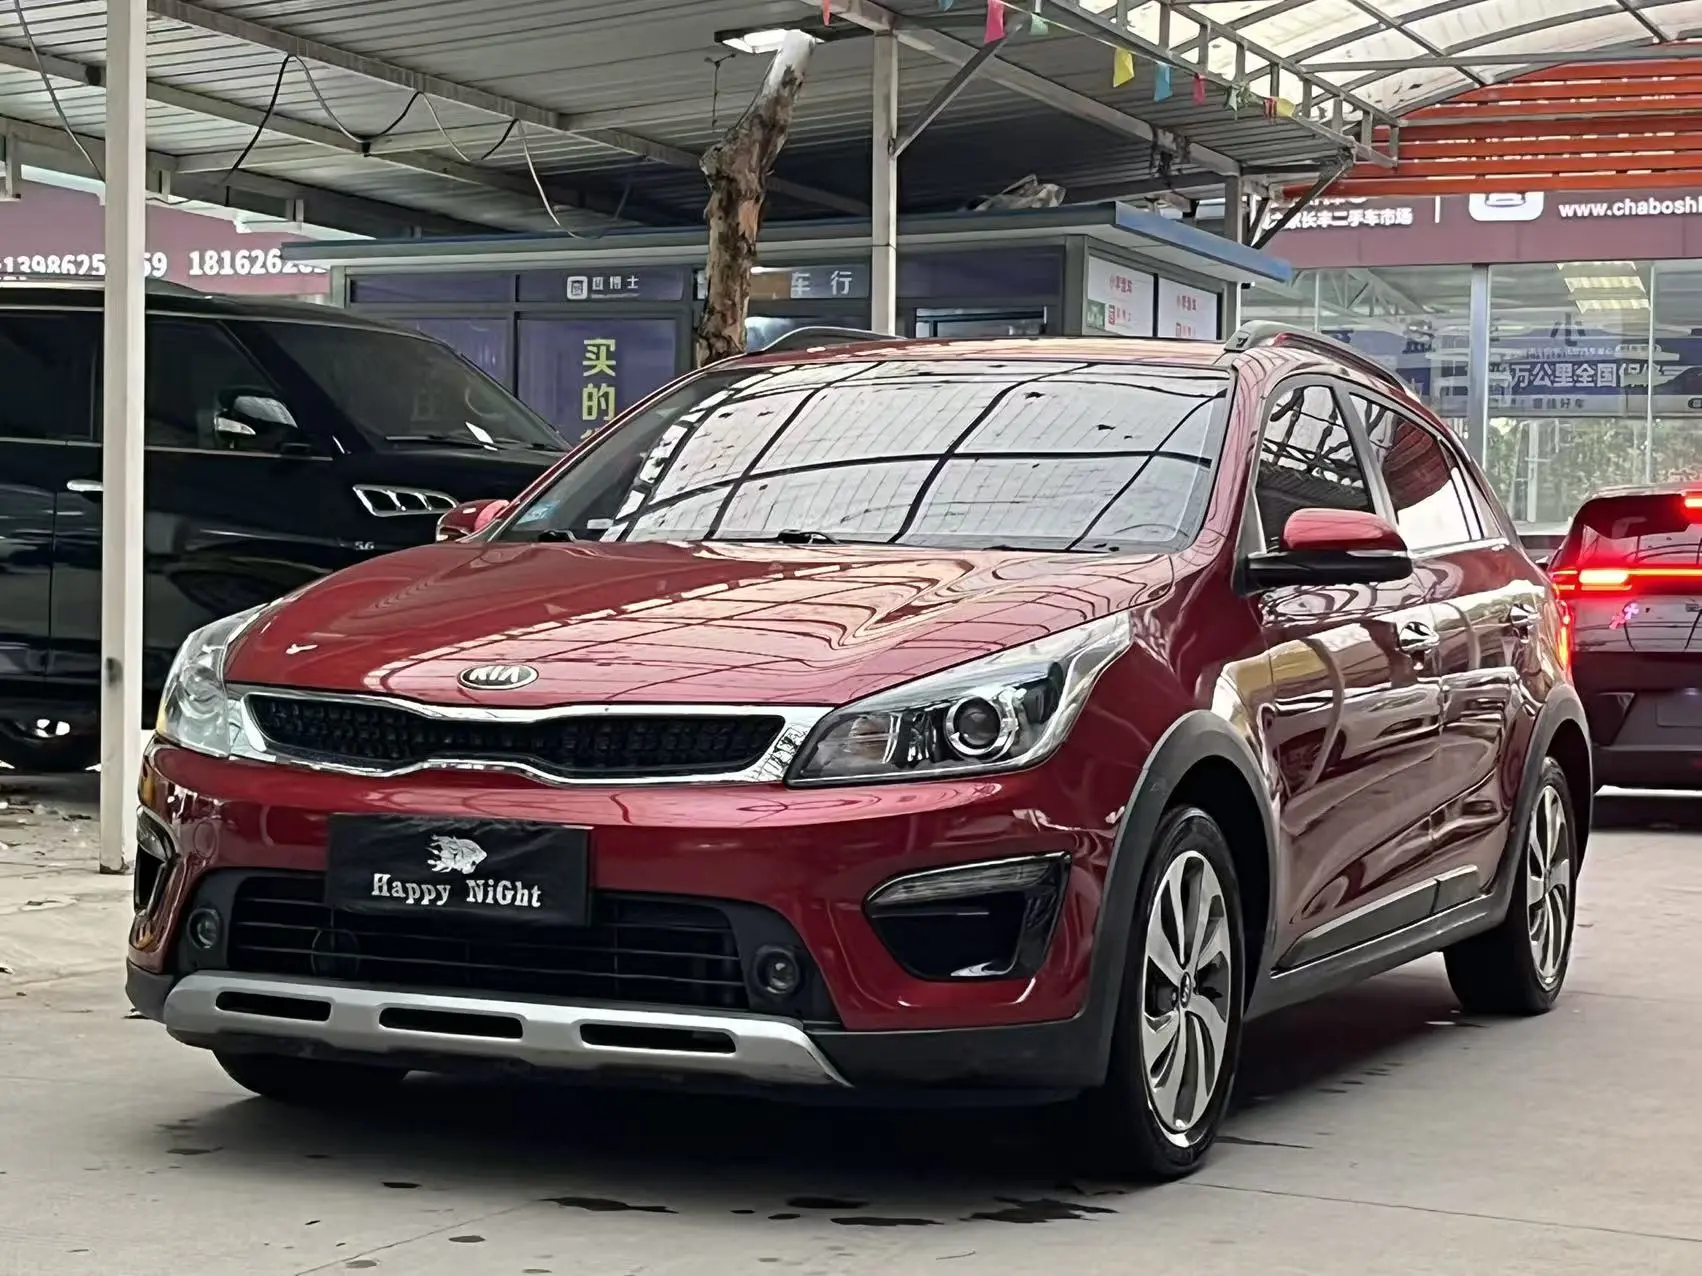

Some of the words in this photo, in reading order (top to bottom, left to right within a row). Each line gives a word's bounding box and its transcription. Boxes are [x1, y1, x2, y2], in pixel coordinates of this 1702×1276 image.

[189, 248, 327, 276] 181626
[582, 338, 616, 439] 买的
[468, 665, 521, 683] KIA
[371, 873, 450, 906] Happy
[466, 880, 541, 907] NiGht
